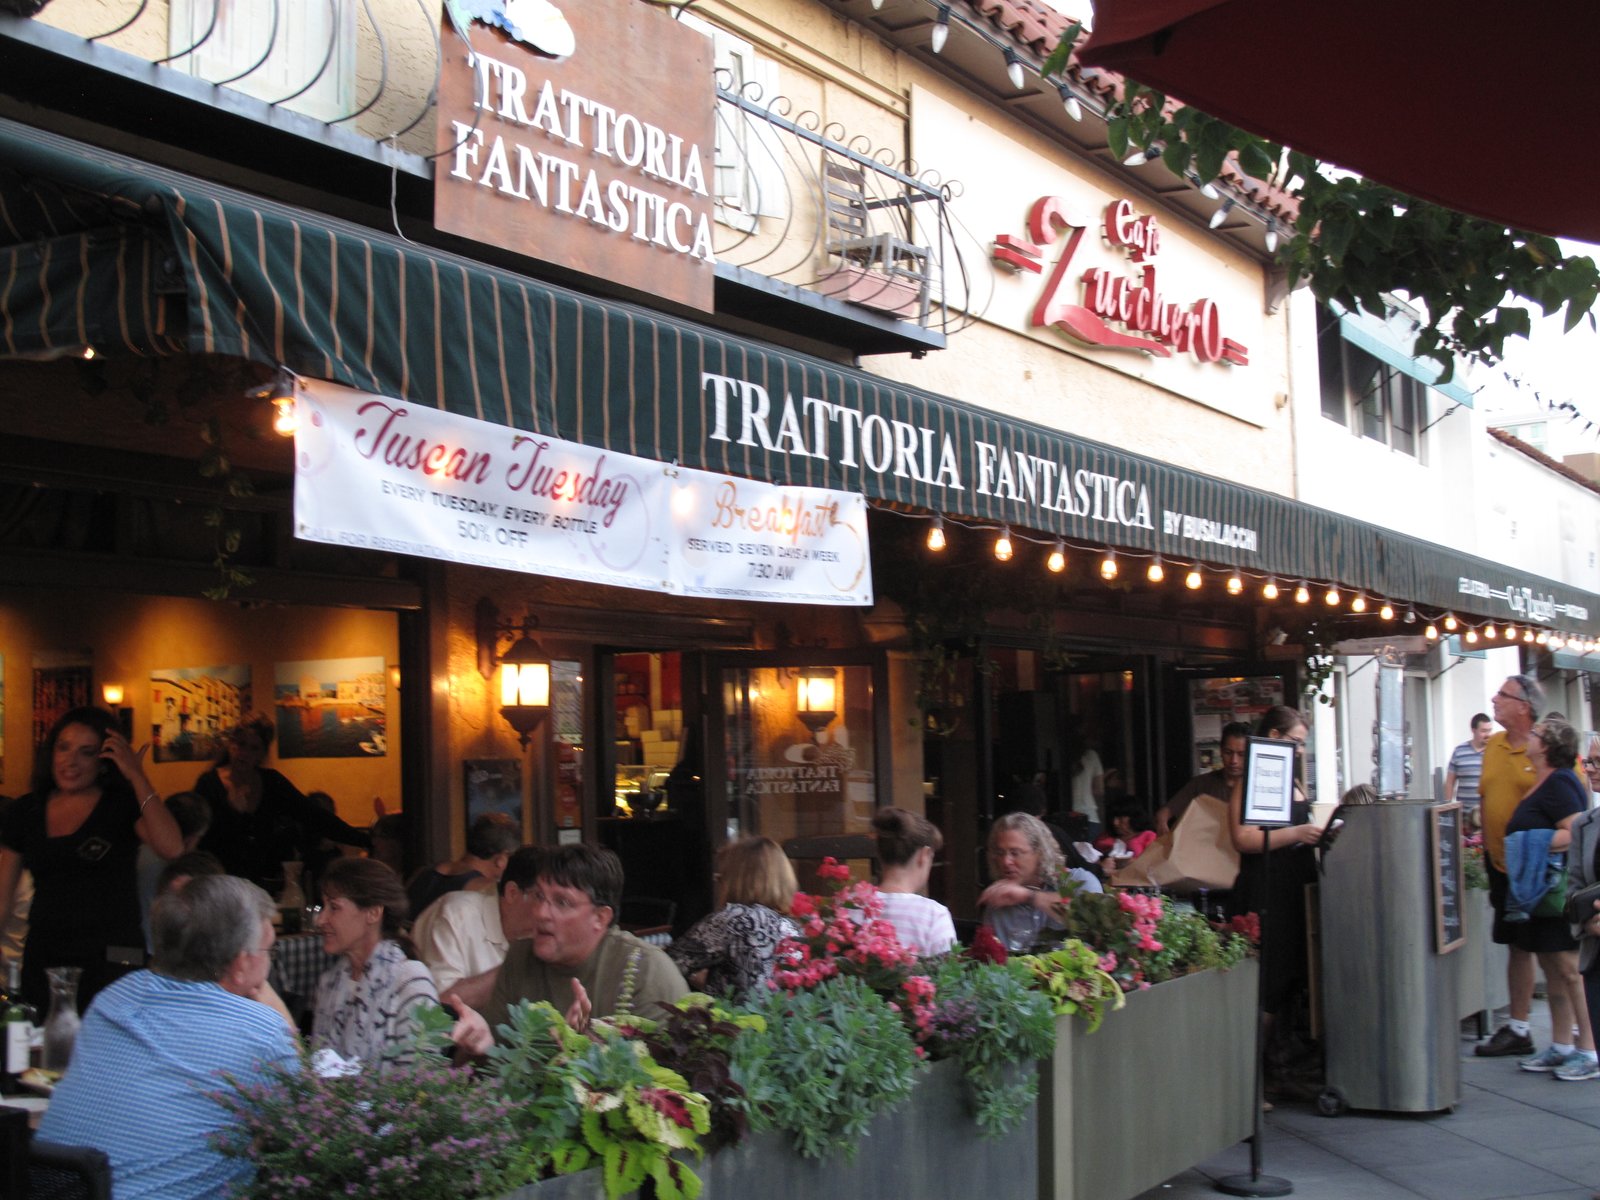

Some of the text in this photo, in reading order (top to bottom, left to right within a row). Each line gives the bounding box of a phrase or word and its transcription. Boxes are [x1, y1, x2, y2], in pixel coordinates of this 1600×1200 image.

[468, 52, 709, 197] TRATTORIA
[451, 120, 717, 264] FANTASTICA
[355, 401, 629, 528] Tuscan Tuesday
[702, 372, 965, 490] TRATTORIA
[975, 441, 1154, 530] FANTASTICA
[381, 479, 426, 502] EVERY
[503, 505, 550, 527] EVERY
[552, 514, 599, 535] BOTTLE
[457, 519, 529, 549] 50% OFF
[687, 537, 733, 555] SERVED
[737, 542, 775, 558] SEVEN
[811, 550, 840, 563] WEEK
[712, 480, 839, 545] Breakfast
